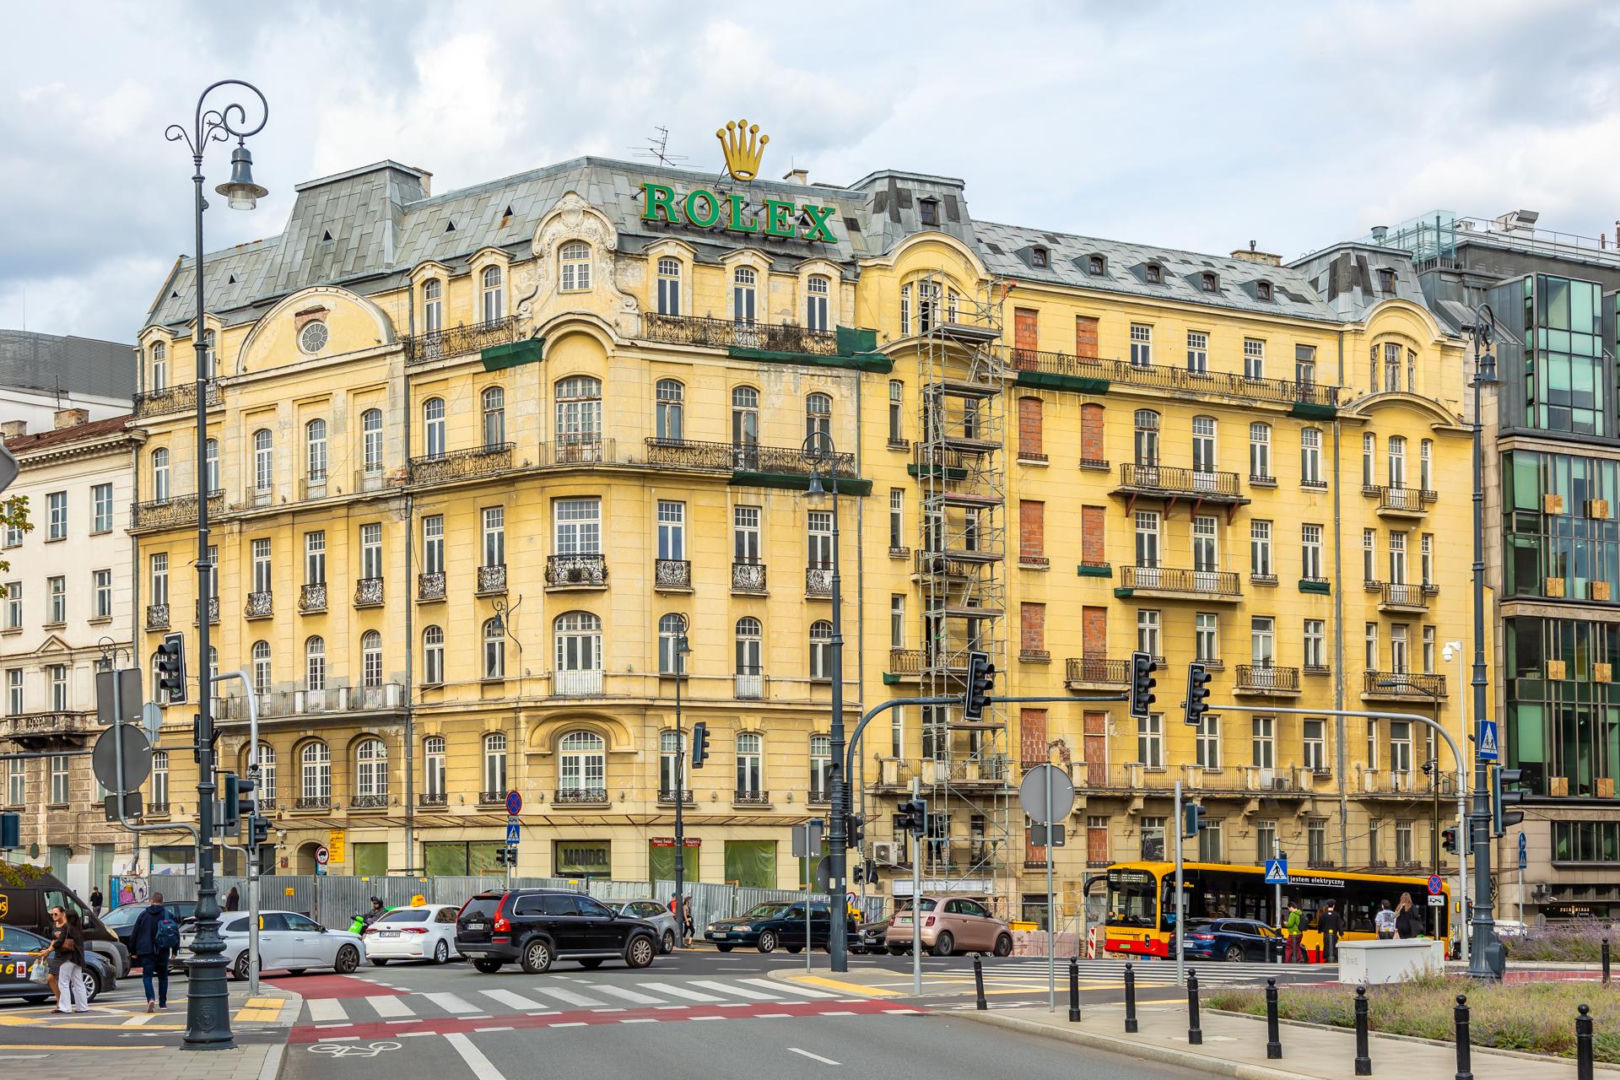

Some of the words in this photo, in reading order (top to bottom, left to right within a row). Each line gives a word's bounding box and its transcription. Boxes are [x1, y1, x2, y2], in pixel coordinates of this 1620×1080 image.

[641, 183, 837, 243] ROLEX
[1290, 875, 1310, 883] jestem
[1311, 877, 1345, 886] elektryczny
